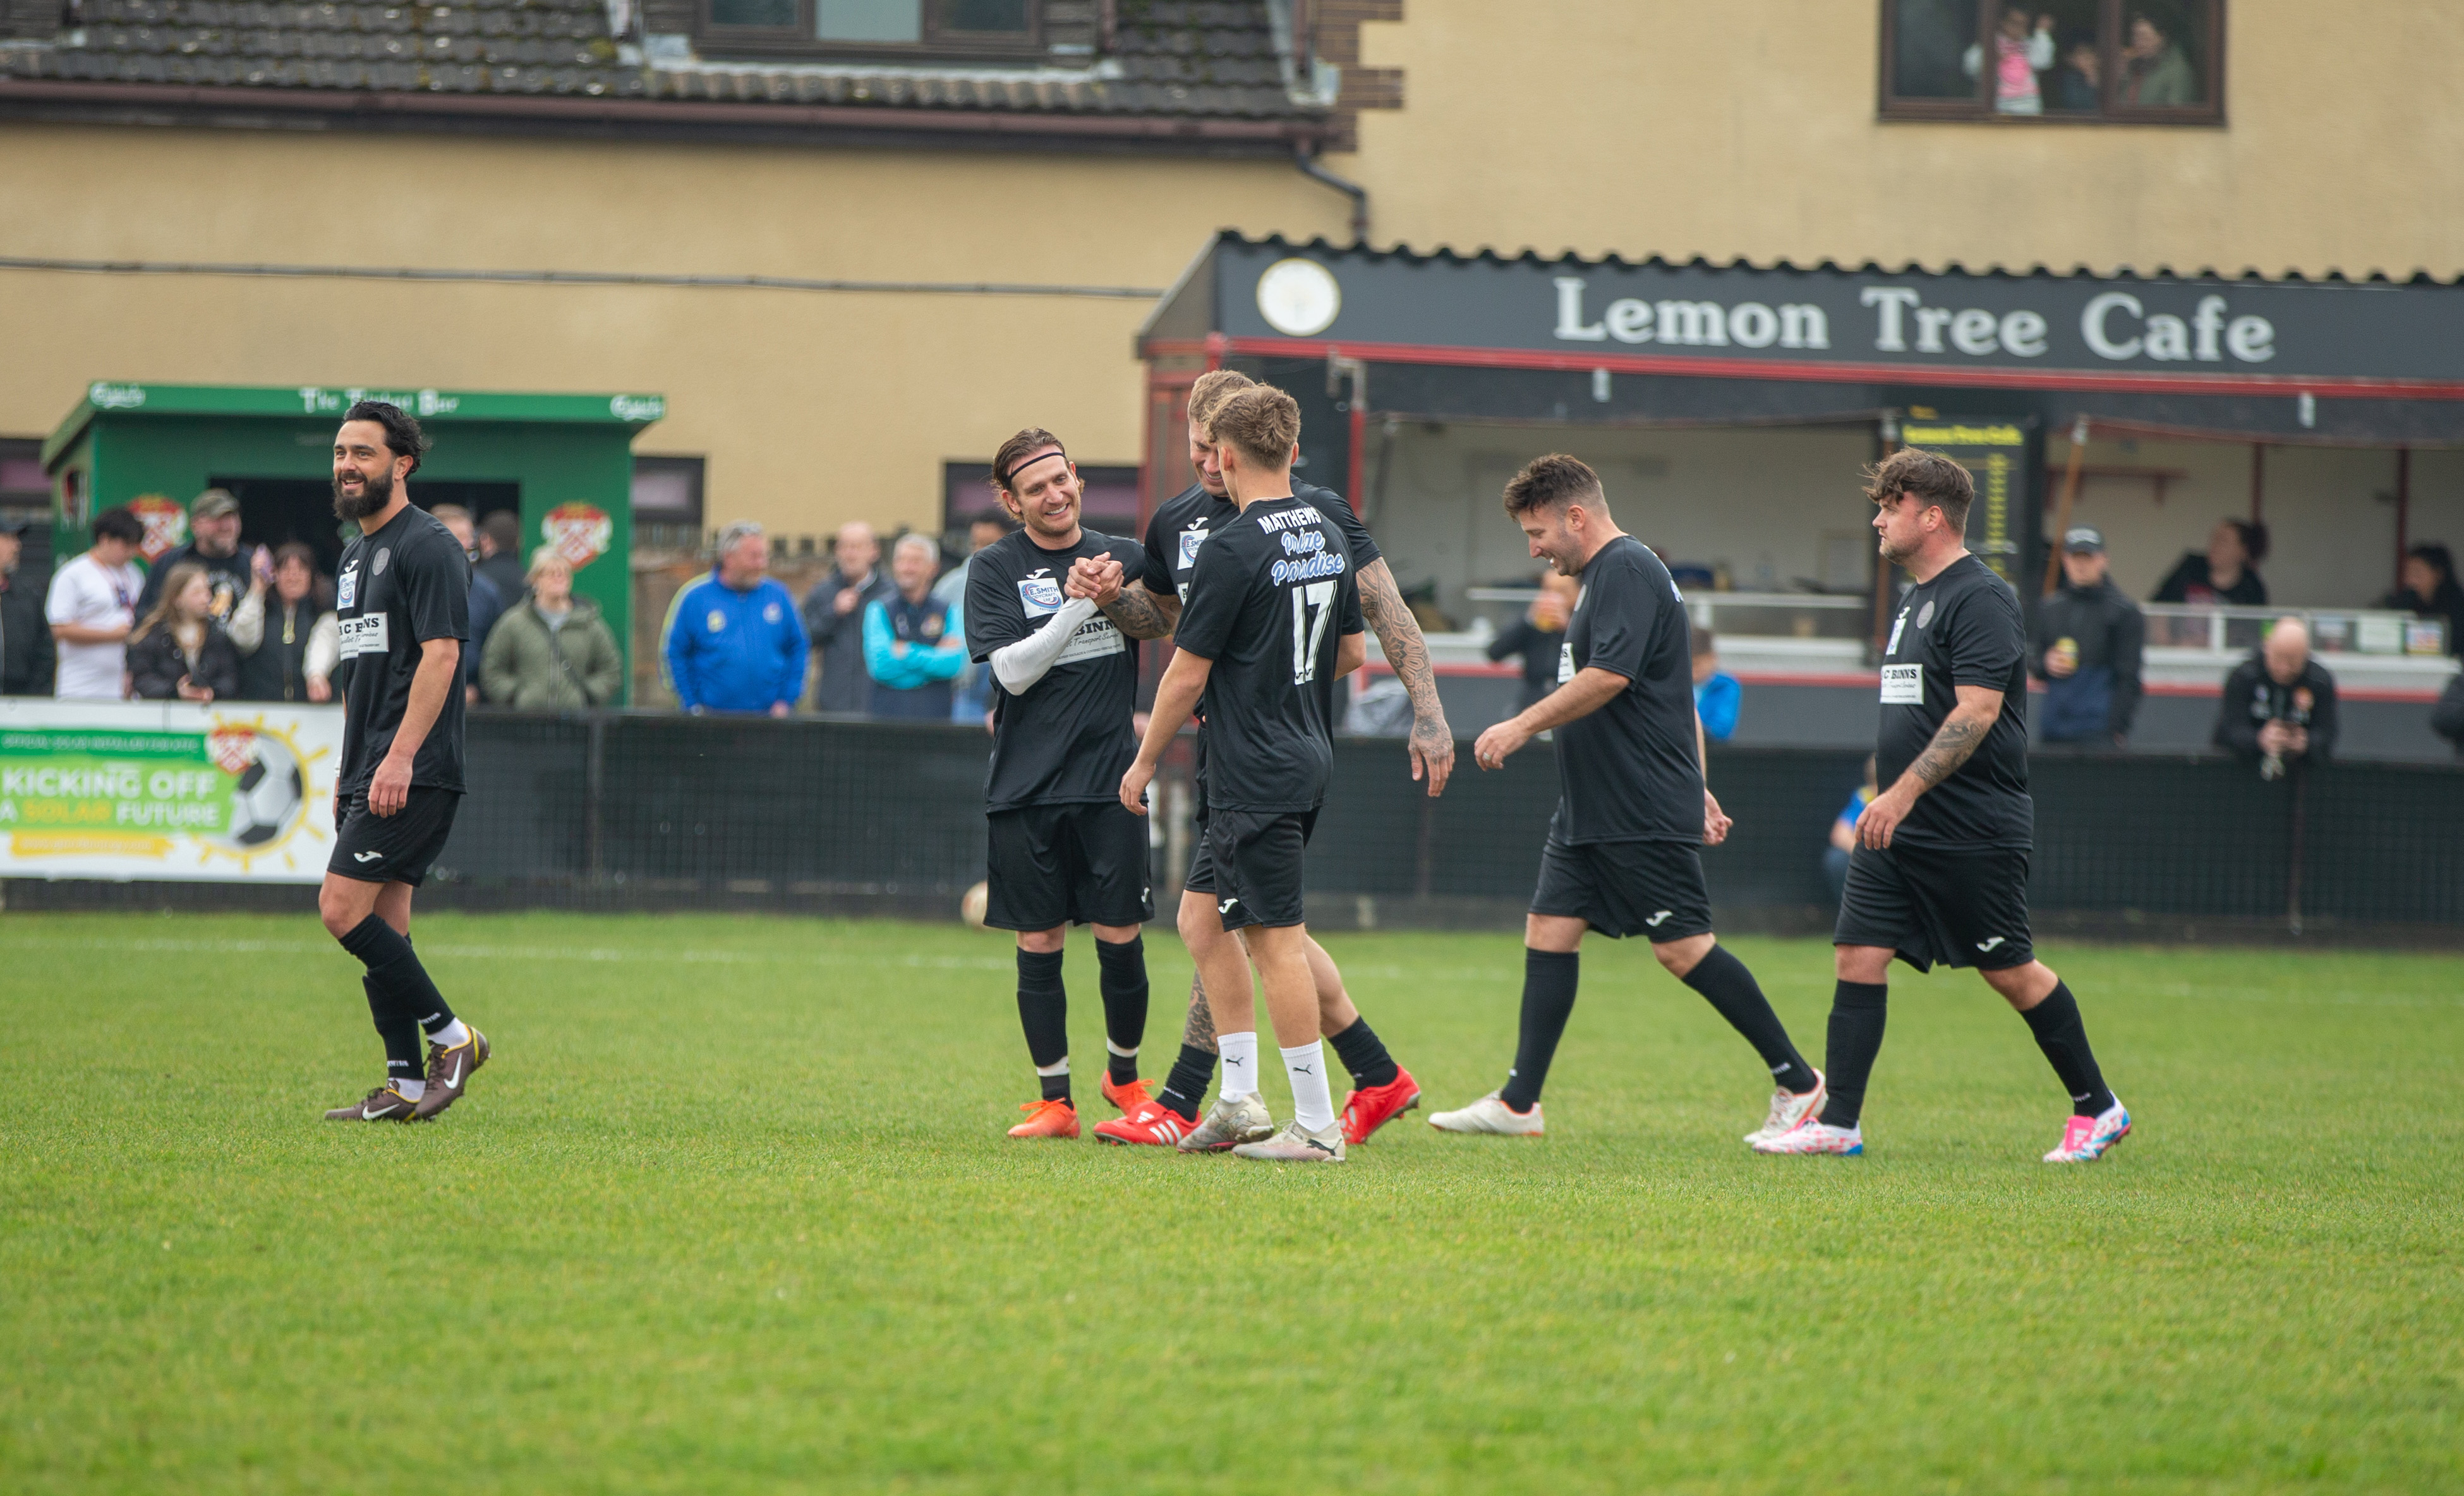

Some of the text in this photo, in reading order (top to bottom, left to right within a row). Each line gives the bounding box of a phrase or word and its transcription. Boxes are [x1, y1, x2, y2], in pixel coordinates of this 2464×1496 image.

[1553, 277, 2276, 363] Lemon Tree Cafe
[299, 387, 339, 413] The
[418, 389, 459, 415] Bar
[1257, 507, 1322, 534] MATTHEWS
[1281, 527, 1326, 556] Prize
[1271, 551, 1345, 586] Paradise
[1074, 620, 1115, 636] BINN
[1074, 634, 1101, 646] Transport
[1293, 580, 1338, 685] 17
[1891, 669, 1917, 679] BINNS
[3, 768, 217, 799] KICKING OFF
[0, 799, 219, 826] A SOLAR FUTURE
